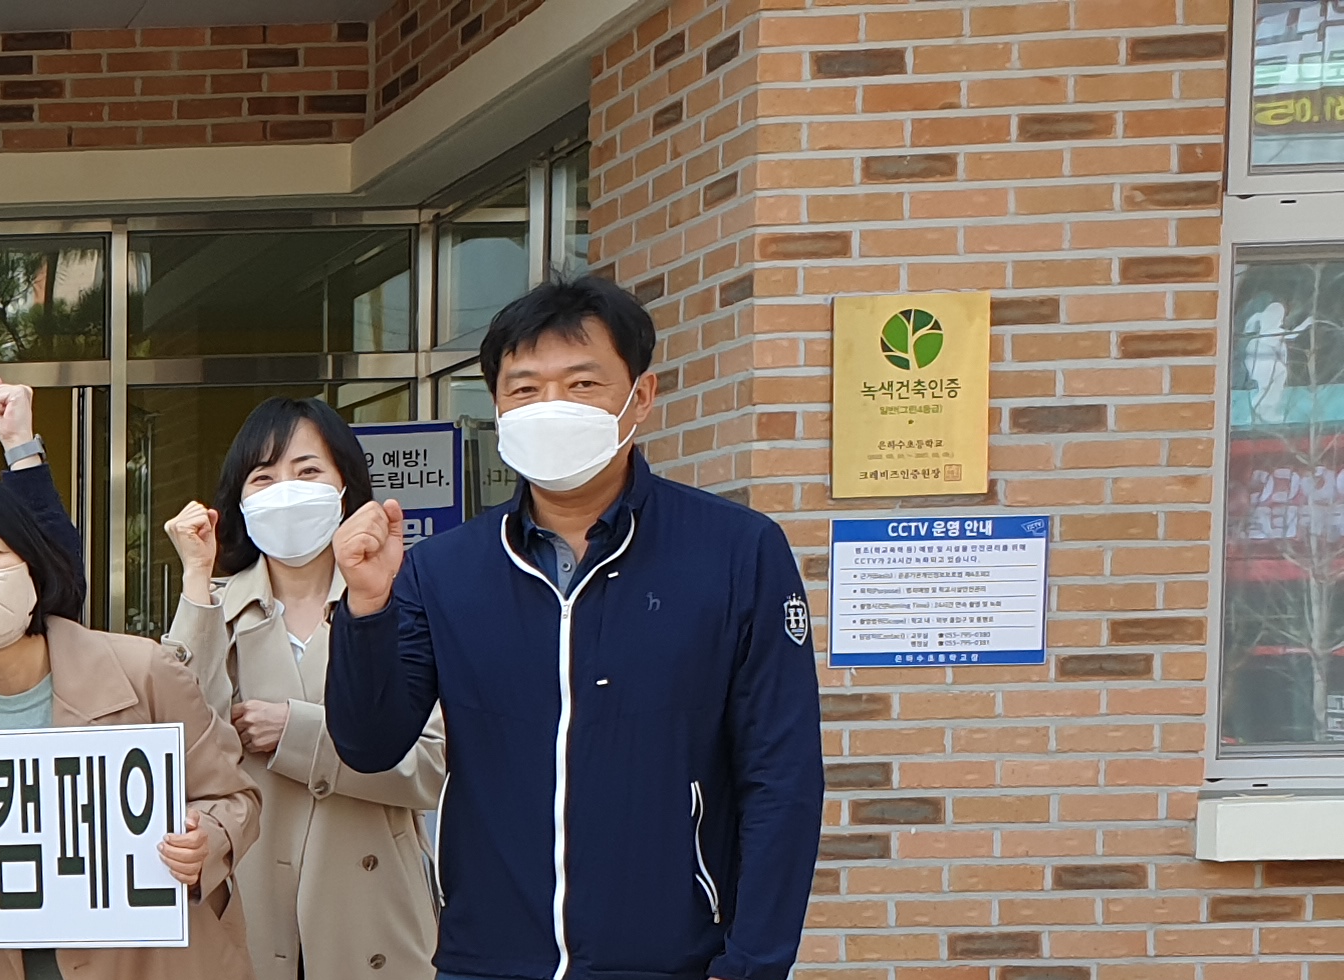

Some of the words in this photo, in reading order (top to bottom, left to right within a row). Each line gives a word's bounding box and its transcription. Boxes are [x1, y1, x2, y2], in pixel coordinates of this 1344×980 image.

[861, 378, 961, 400] 녹색건축인증
[878, 439, 943, 450] 은하수초등학교
[383, 449, 428, 468] 예방!
[888, 522, 928, 537] CCTV
[932, 521, 960, 536] 운영
[964, 520, 993, 536] 안내
